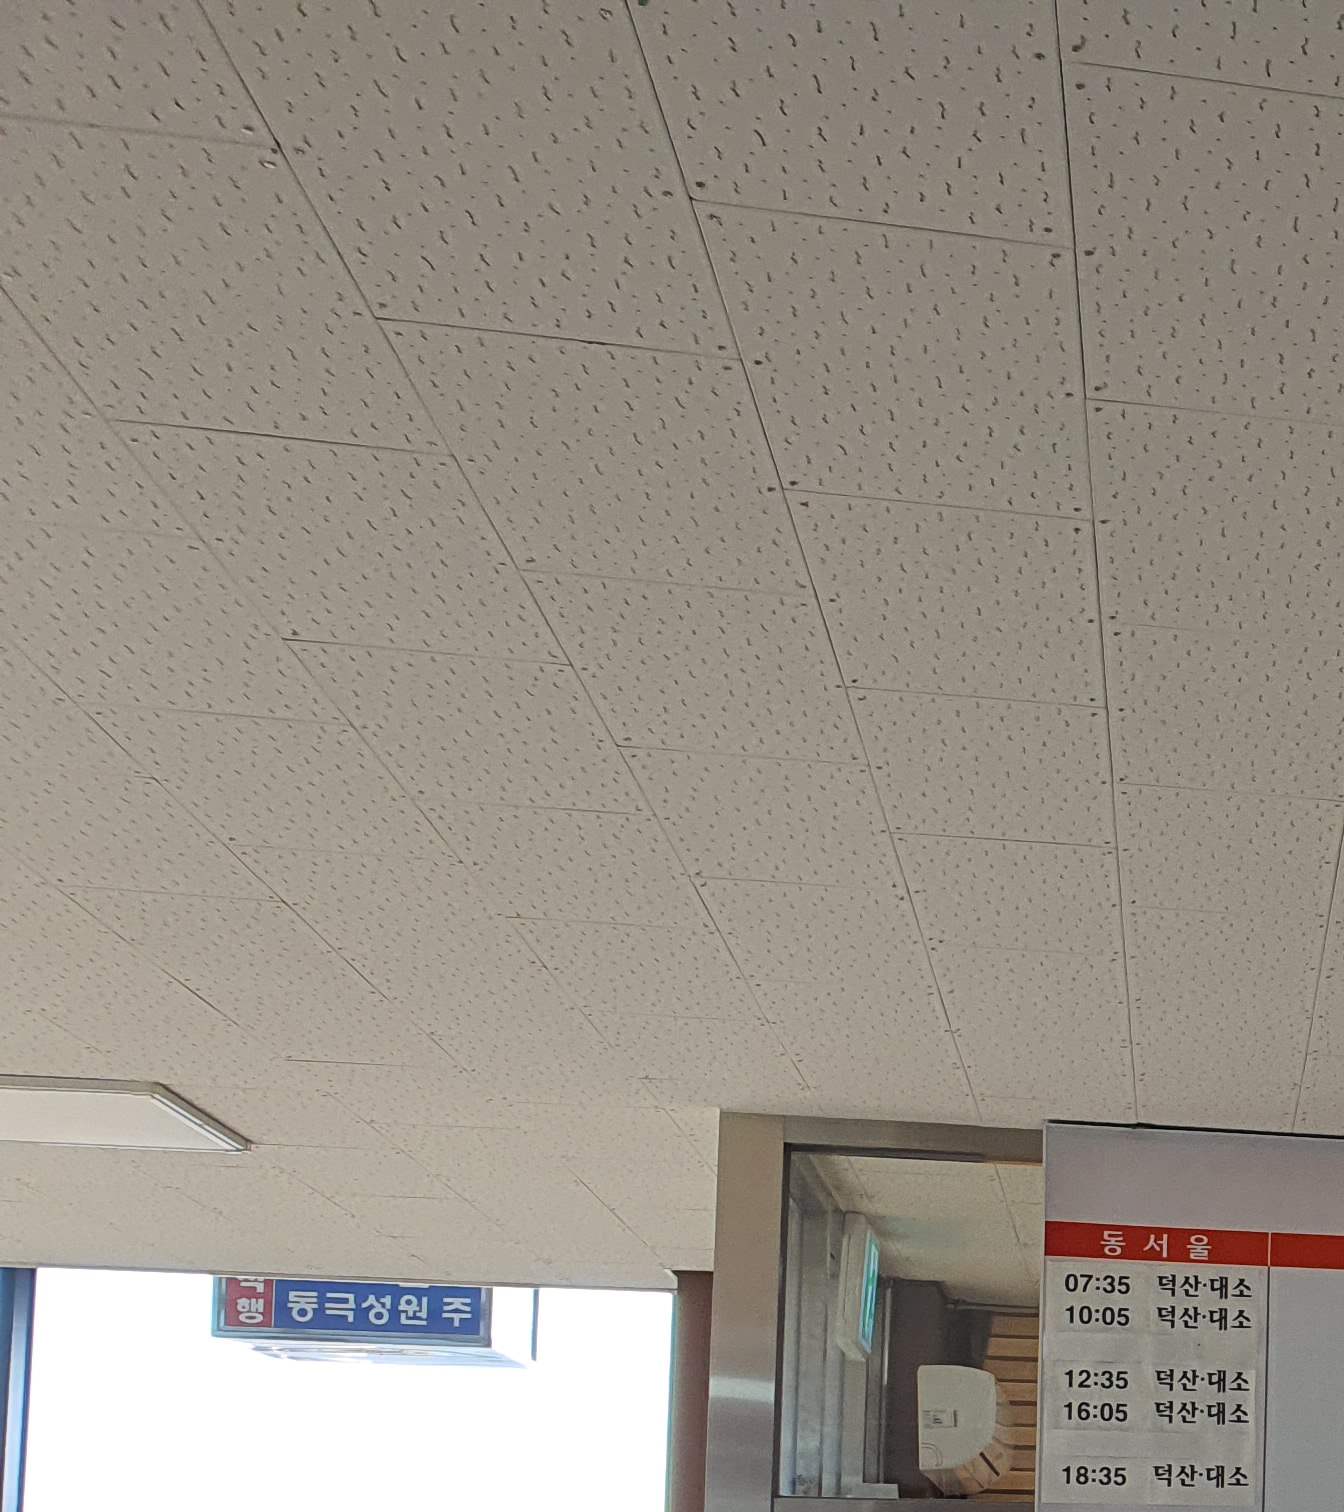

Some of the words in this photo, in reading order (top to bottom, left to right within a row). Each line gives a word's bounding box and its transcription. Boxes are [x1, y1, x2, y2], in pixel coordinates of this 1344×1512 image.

[1065, 1274, 1130, 1294] 07:35
[1066, 1306, 1129, 1326] 10:05
[1065, 1370, 1128, 1389] 12:35
[1064, 1402, 1127, 1422] 16:05
[1063, 1466, 1126, 1485] 18:35
